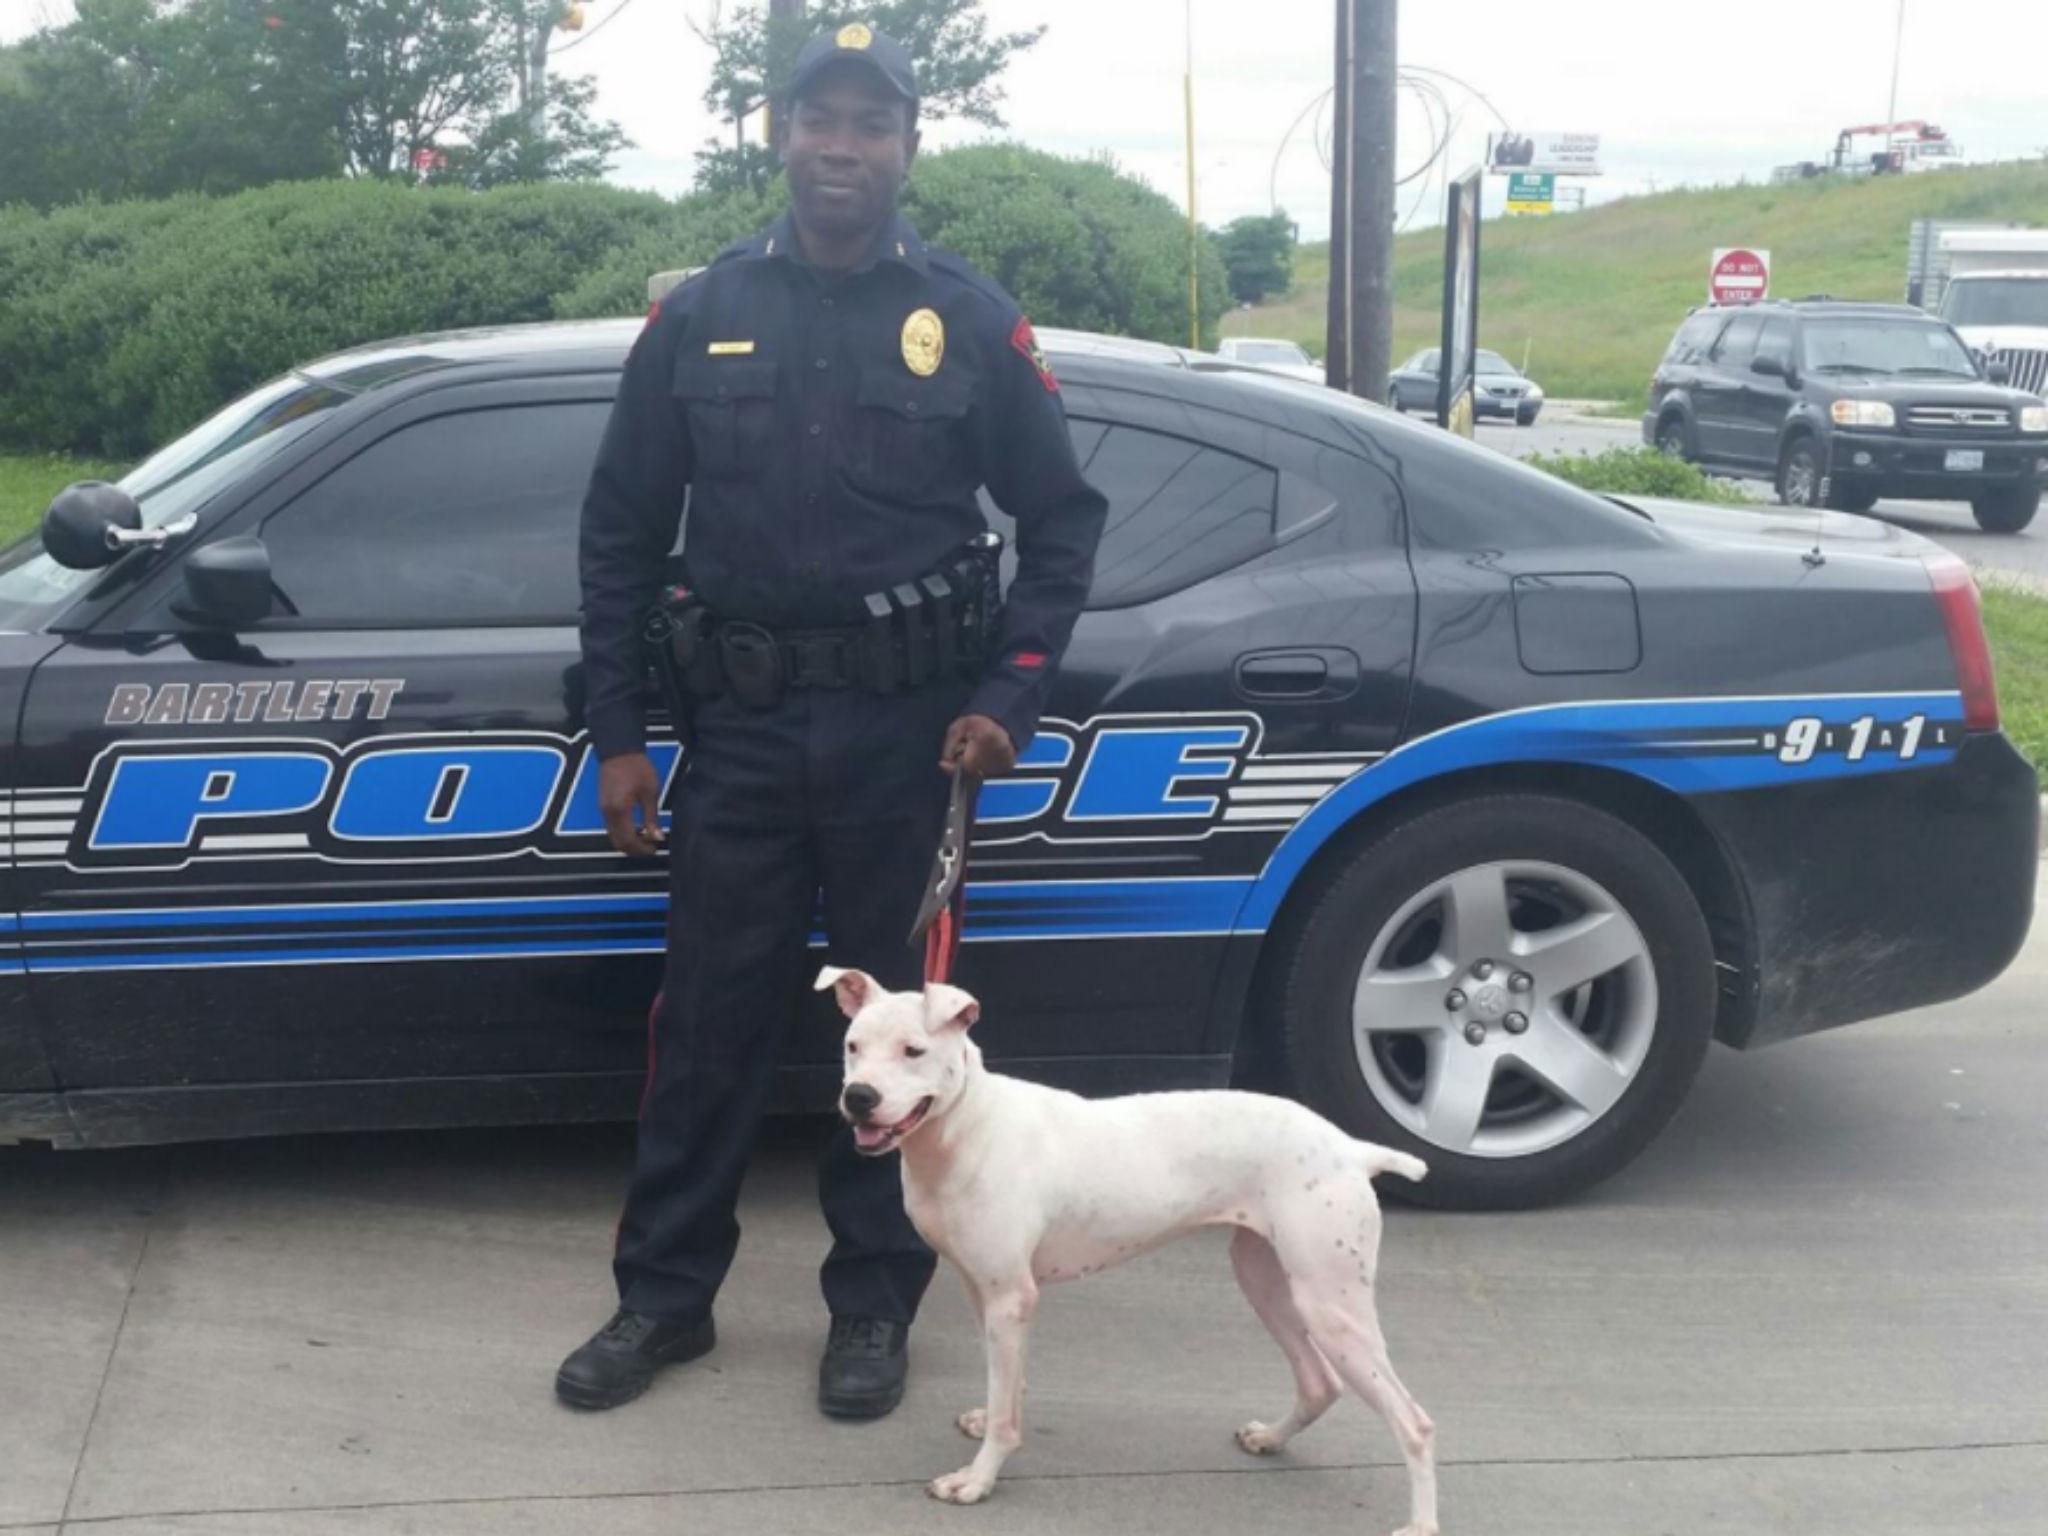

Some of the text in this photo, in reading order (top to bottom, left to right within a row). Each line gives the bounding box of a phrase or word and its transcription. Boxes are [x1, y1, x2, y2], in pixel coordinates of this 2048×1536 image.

[1722, 262, 1759, 274] DO NOT
[1722, 289, 1752, 301] ENTER
[104, 678, 405, 725] BARTLETT
